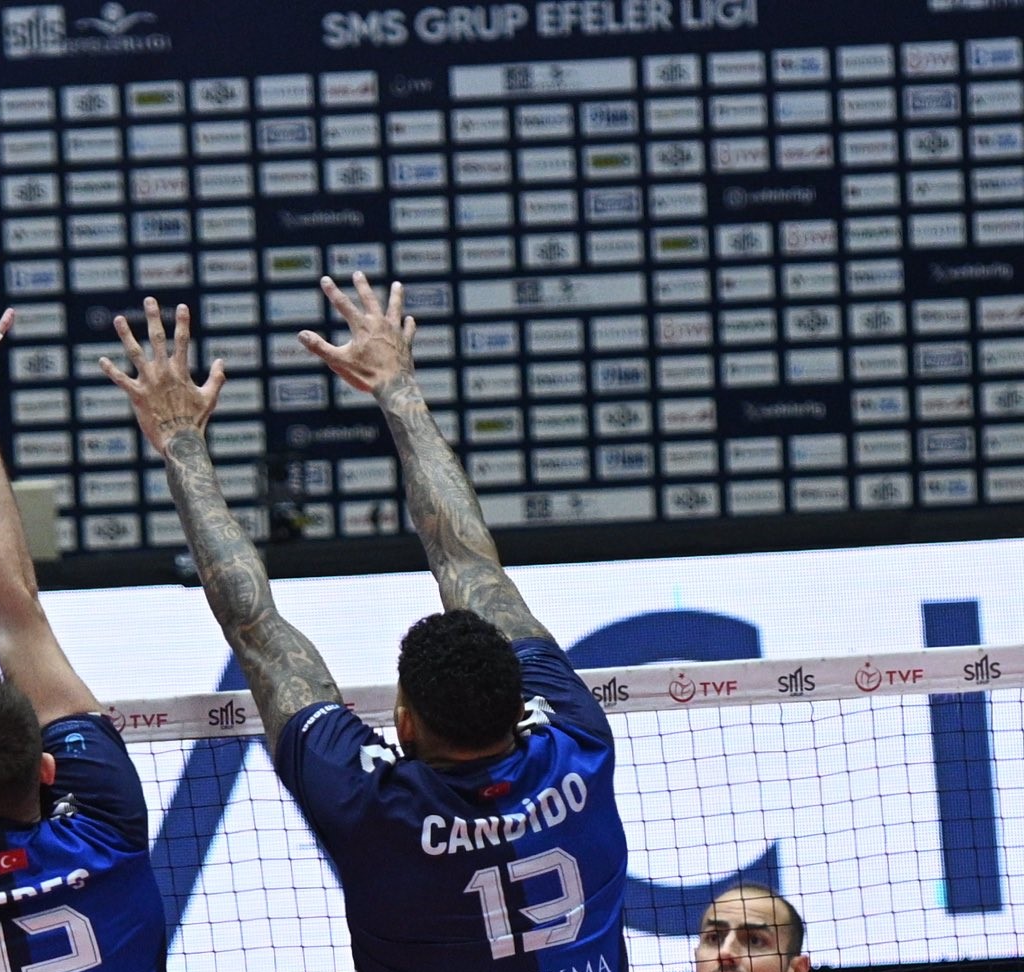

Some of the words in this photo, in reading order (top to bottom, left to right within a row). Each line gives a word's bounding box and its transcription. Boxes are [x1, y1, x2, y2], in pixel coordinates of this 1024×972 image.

[321, 11, 408, 48] SMS
[413, 3, 529, 43] GRUP
[536, 0, 674, 37] EFELER
[777, 665, 816, 695] SMS
[884, 668, 924, 684] TVF
[963, 653, 1002, 685] SMS
[699, 680, 738, 697] TVF
[129, 713, 168, 729] TVF
[207, 698, 247, 727] SMS
[462, 846, 586, 961] 13
